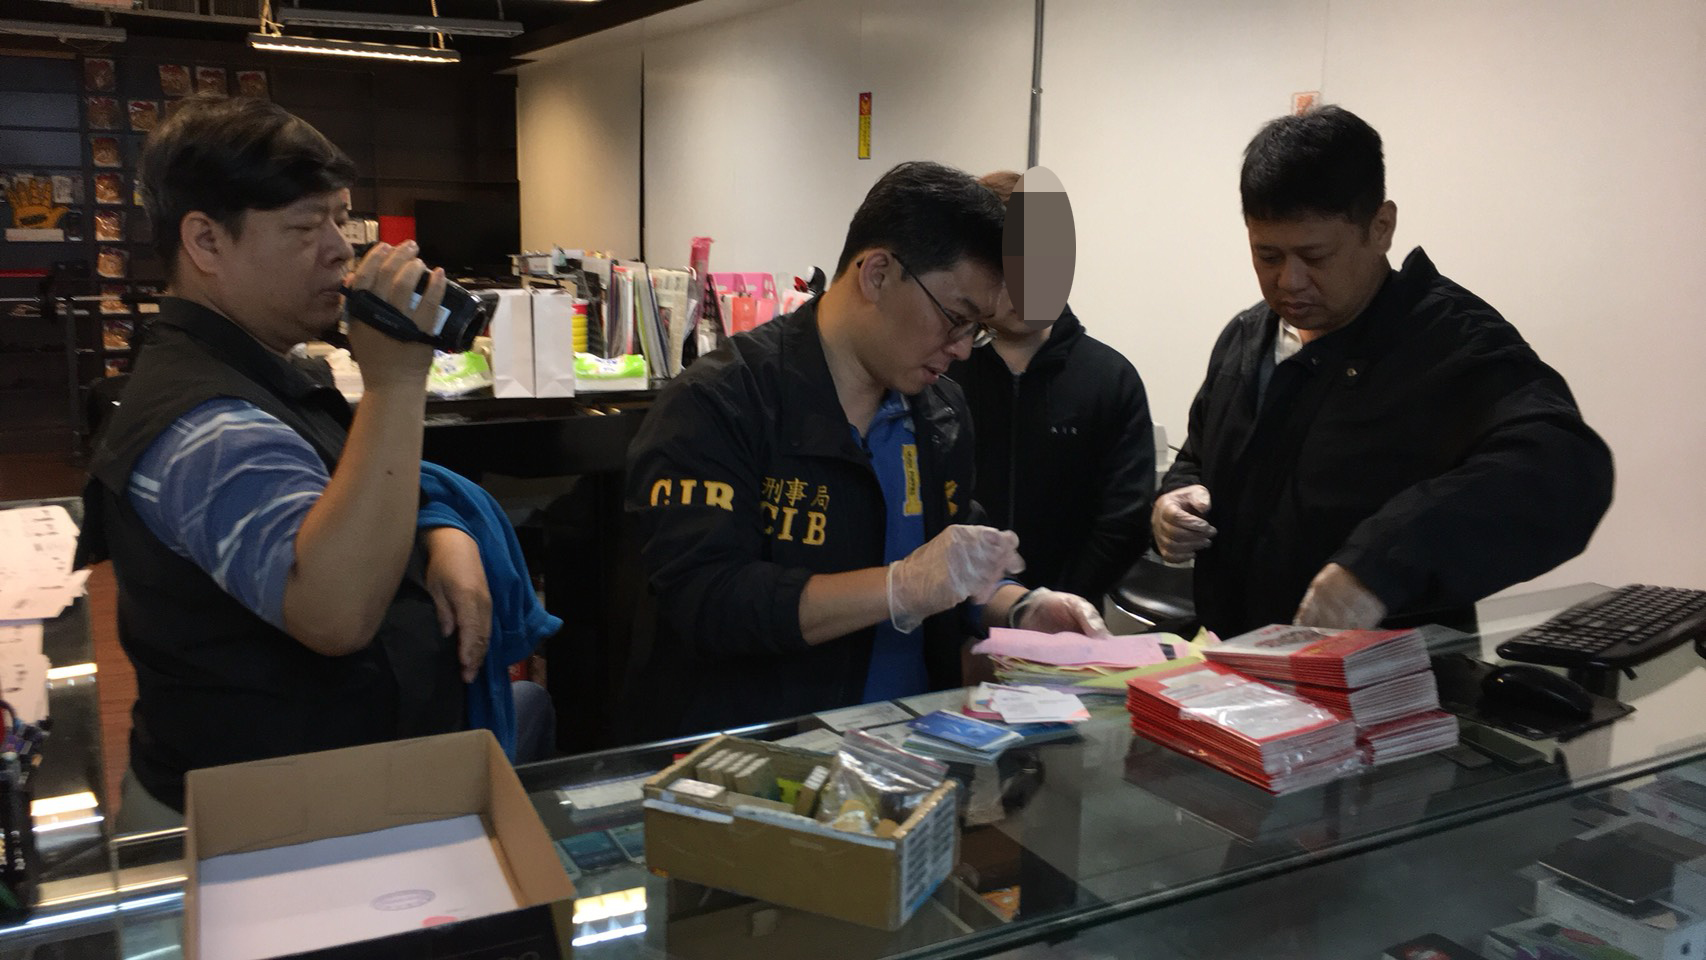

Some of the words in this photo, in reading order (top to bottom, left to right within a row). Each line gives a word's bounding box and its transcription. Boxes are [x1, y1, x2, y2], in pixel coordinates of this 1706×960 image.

[762, 476, 830, 511] 刑事局
[761, 501, 827, 546] CIB
